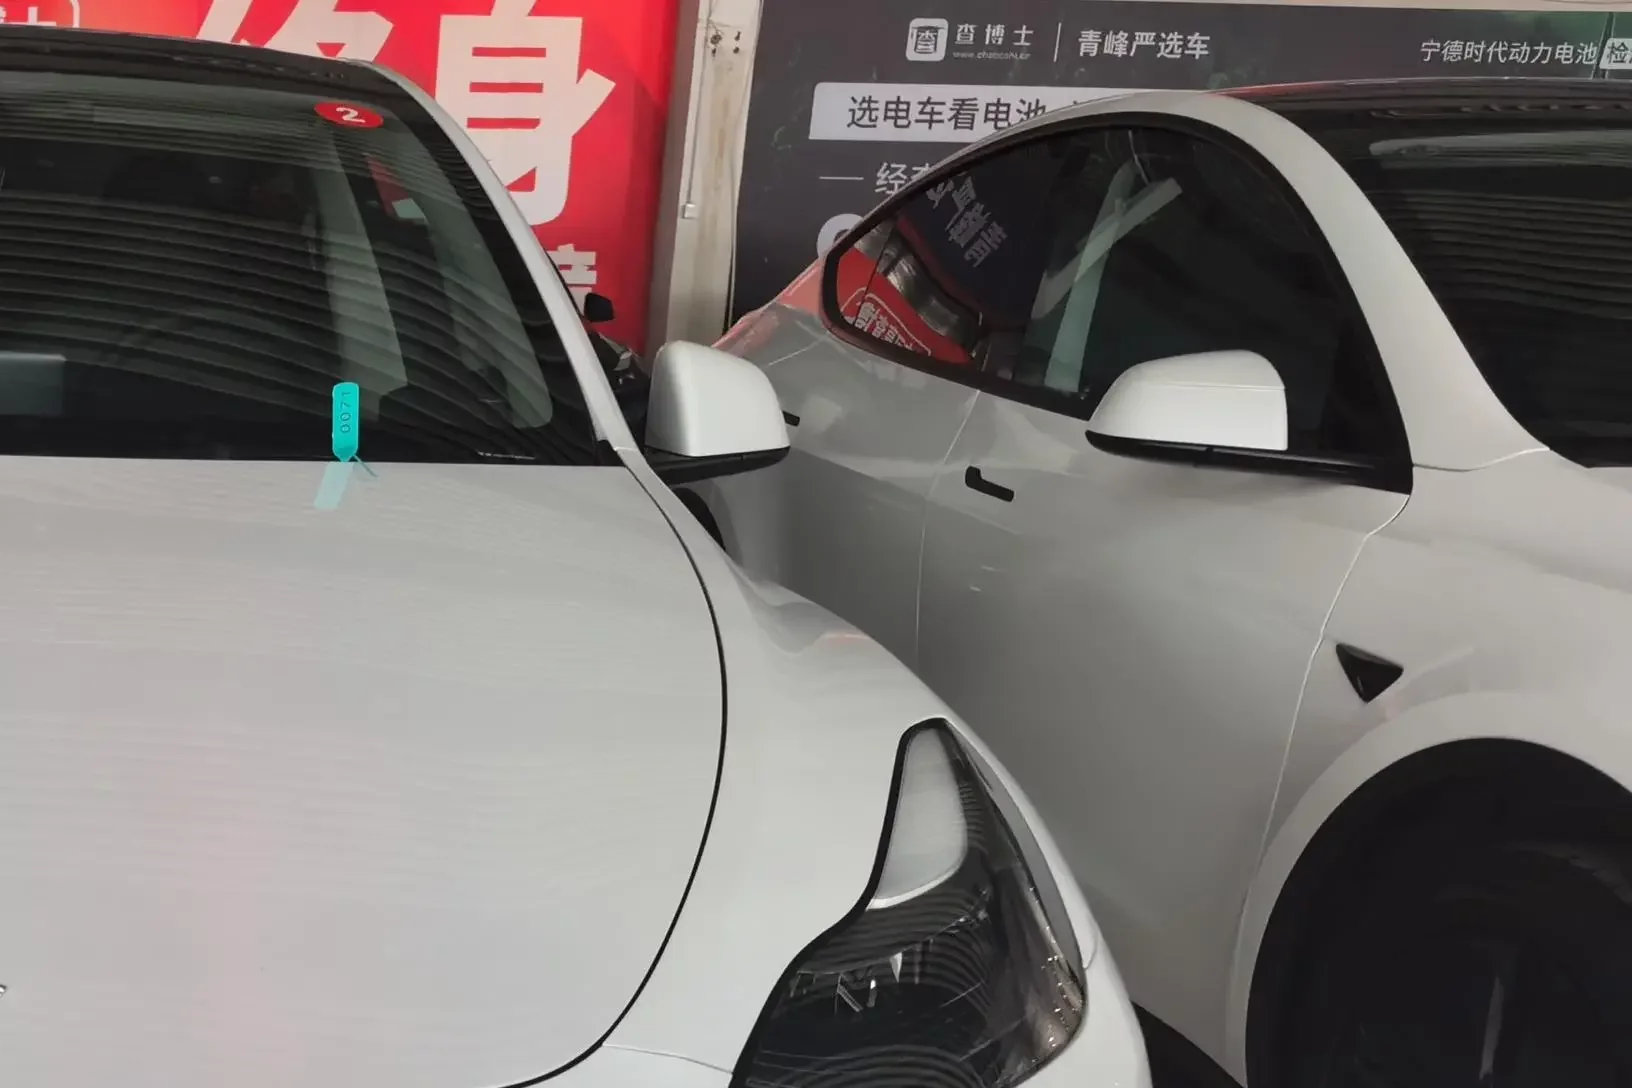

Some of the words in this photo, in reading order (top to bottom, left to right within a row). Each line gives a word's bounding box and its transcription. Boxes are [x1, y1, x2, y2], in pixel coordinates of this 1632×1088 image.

[954, 24, 1034, 46] 查博士
[1078, 29, 1211, 59] 青峰严选车
[1420, 38, 1598, 65] 宁德时代动力电池
[335, 107, 366, 123] 2
